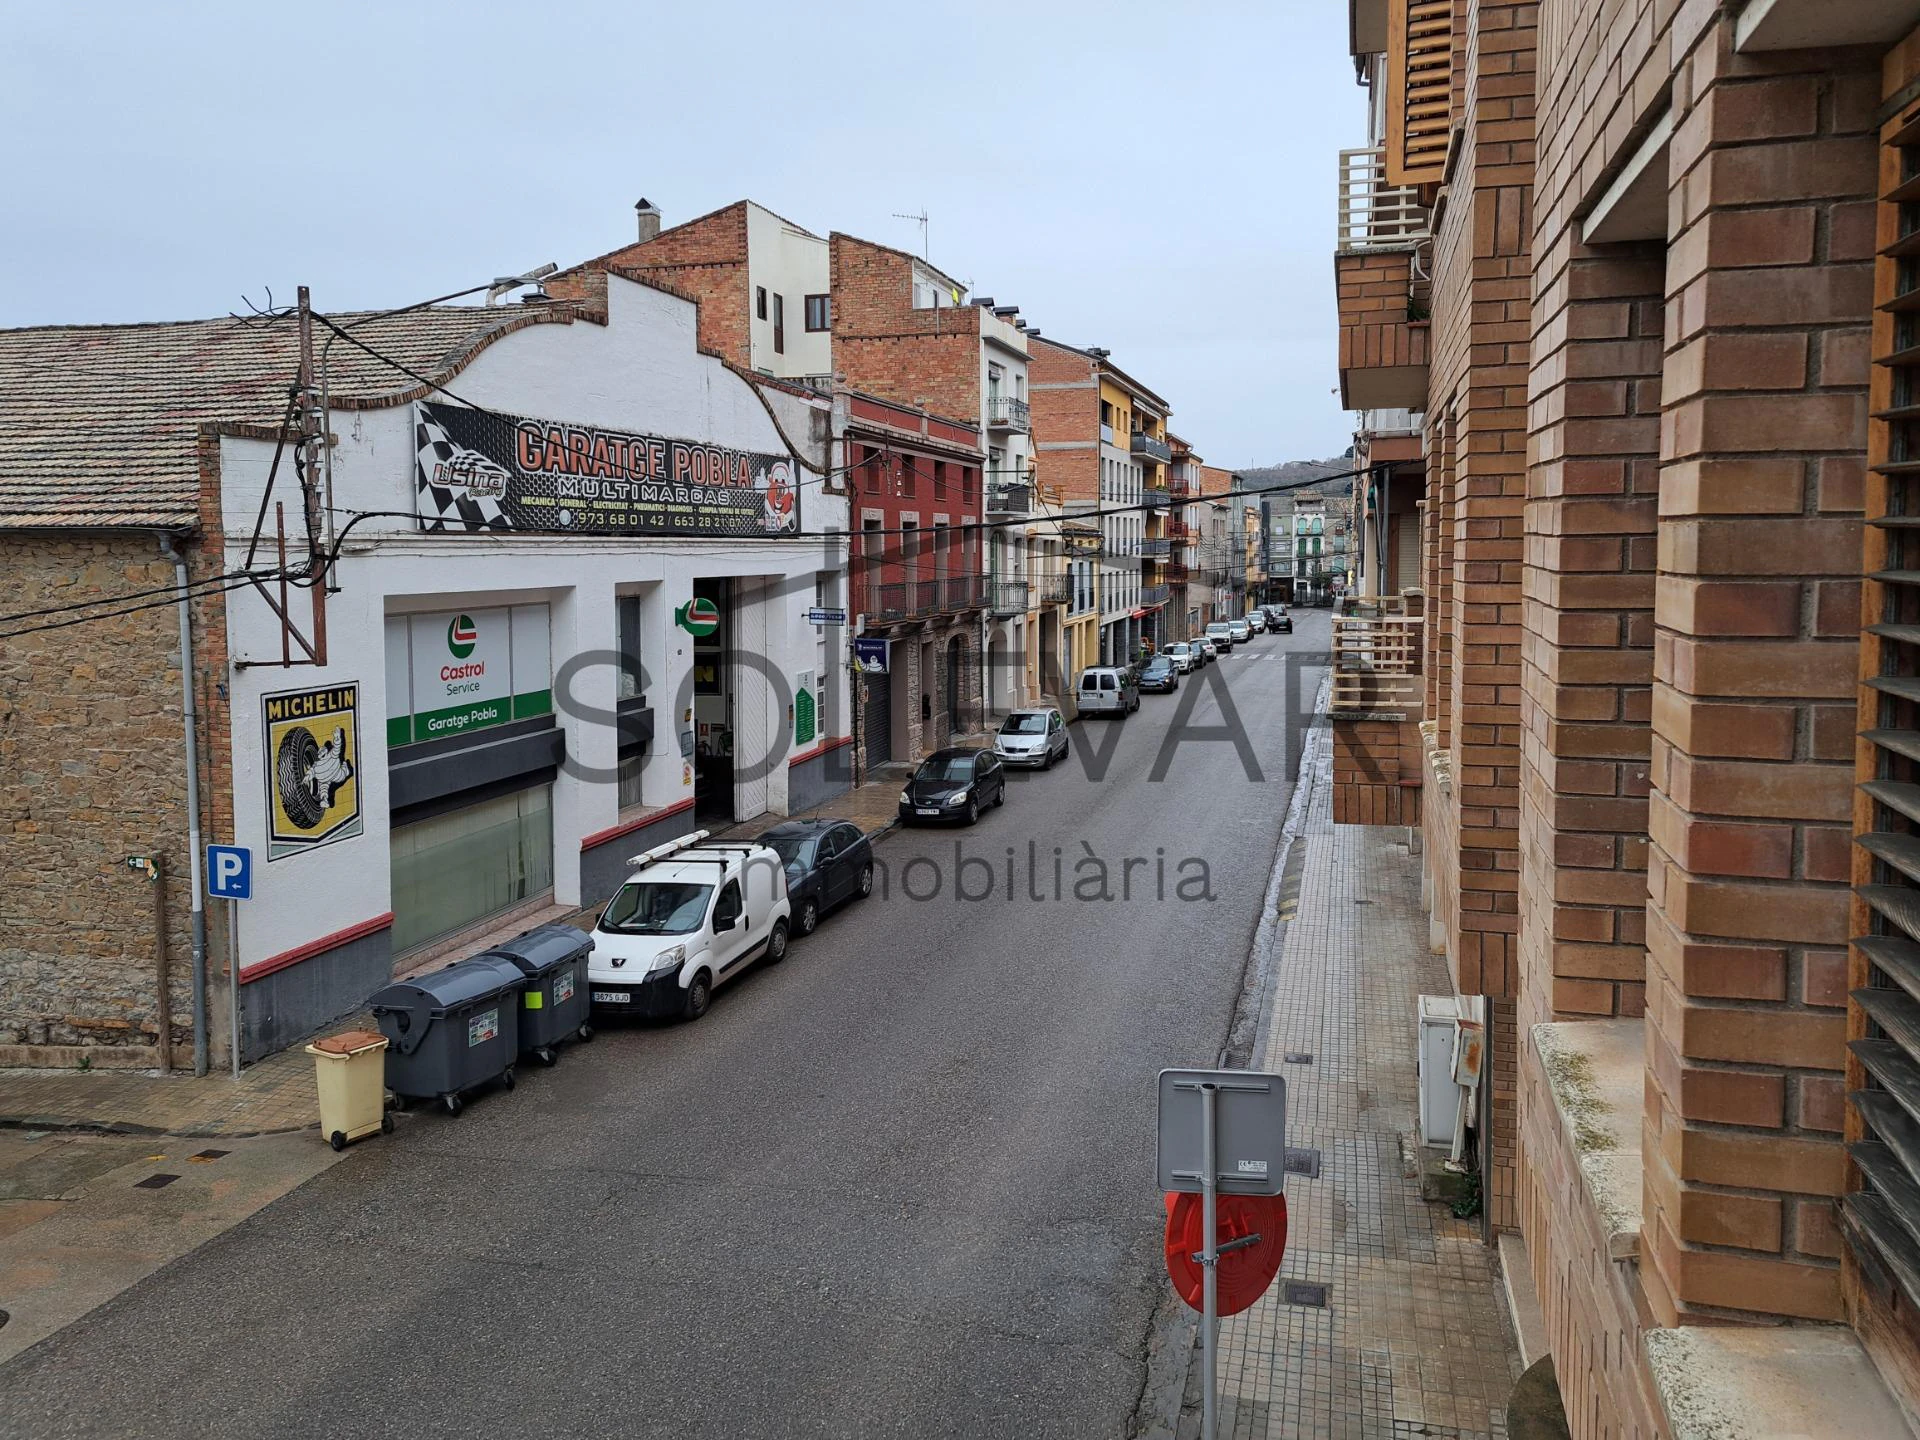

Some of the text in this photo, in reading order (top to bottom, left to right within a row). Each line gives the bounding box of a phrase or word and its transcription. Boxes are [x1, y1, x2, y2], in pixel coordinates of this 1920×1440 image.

[516, 420, 753, 491] GARATGE POBLA
[433, 463, 505, 488] Usina
[559, 478, 731, 505] MULTIMARCAS
[559, 498, 588, 509] GENERAL
[578, 512, 604, 525] 973
[609, 513, 626, 526] 68
[630, 514, 644, 526] 01
[649, 515, 665, 526] 42
[674, 516, 695, 527] 663
[698, 516, 711, 528] 28
[440, 660, 485, 681] Castrol
[446, 681, 480, 696] Service
[268, 689, 355, 721] MICHELIN
[428, 707, 498, 731] Garatge Pobla
[216, 852, 243, 890] P
